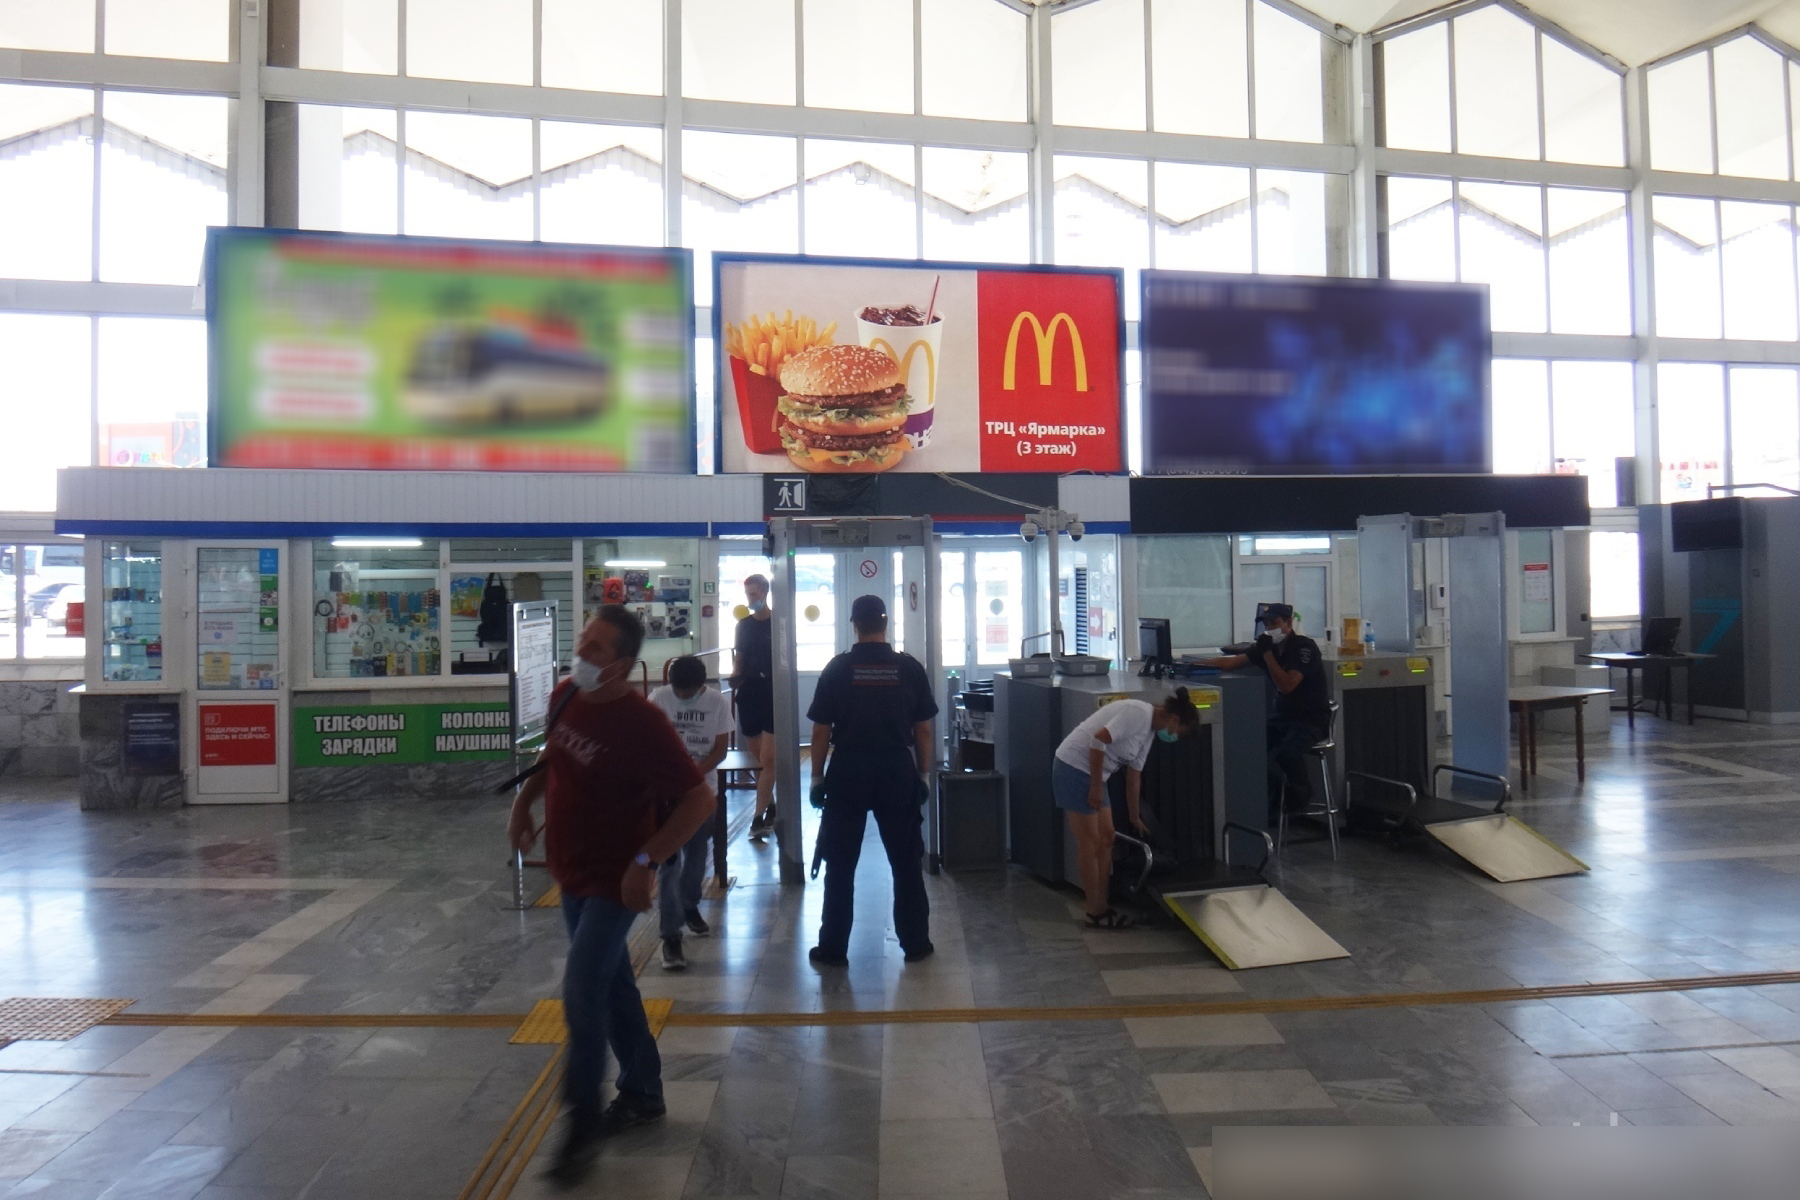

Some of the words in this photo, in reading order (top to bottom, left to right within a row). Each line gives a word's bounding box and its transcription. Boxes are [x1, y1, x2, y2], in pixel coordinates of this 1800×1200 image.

[985, 421, 1016, 437] ТРЦ
[1018, 421, 1106, 439] «Ярмарка»
[1016, 440, 1032, 457] (3
[1034, 440, 1077, 457] этаж)
[313, 713, 405, 733] ТЕЛЕФОНЫ
[676, 711, 705, 722] WORLD
[204, 726, 249, 734] ПОДКЛЮЧИ
[204, 733, 230, 741] ЗДЕСЬ
[322, 737, 397, 757] ЗАРЯДКИ
